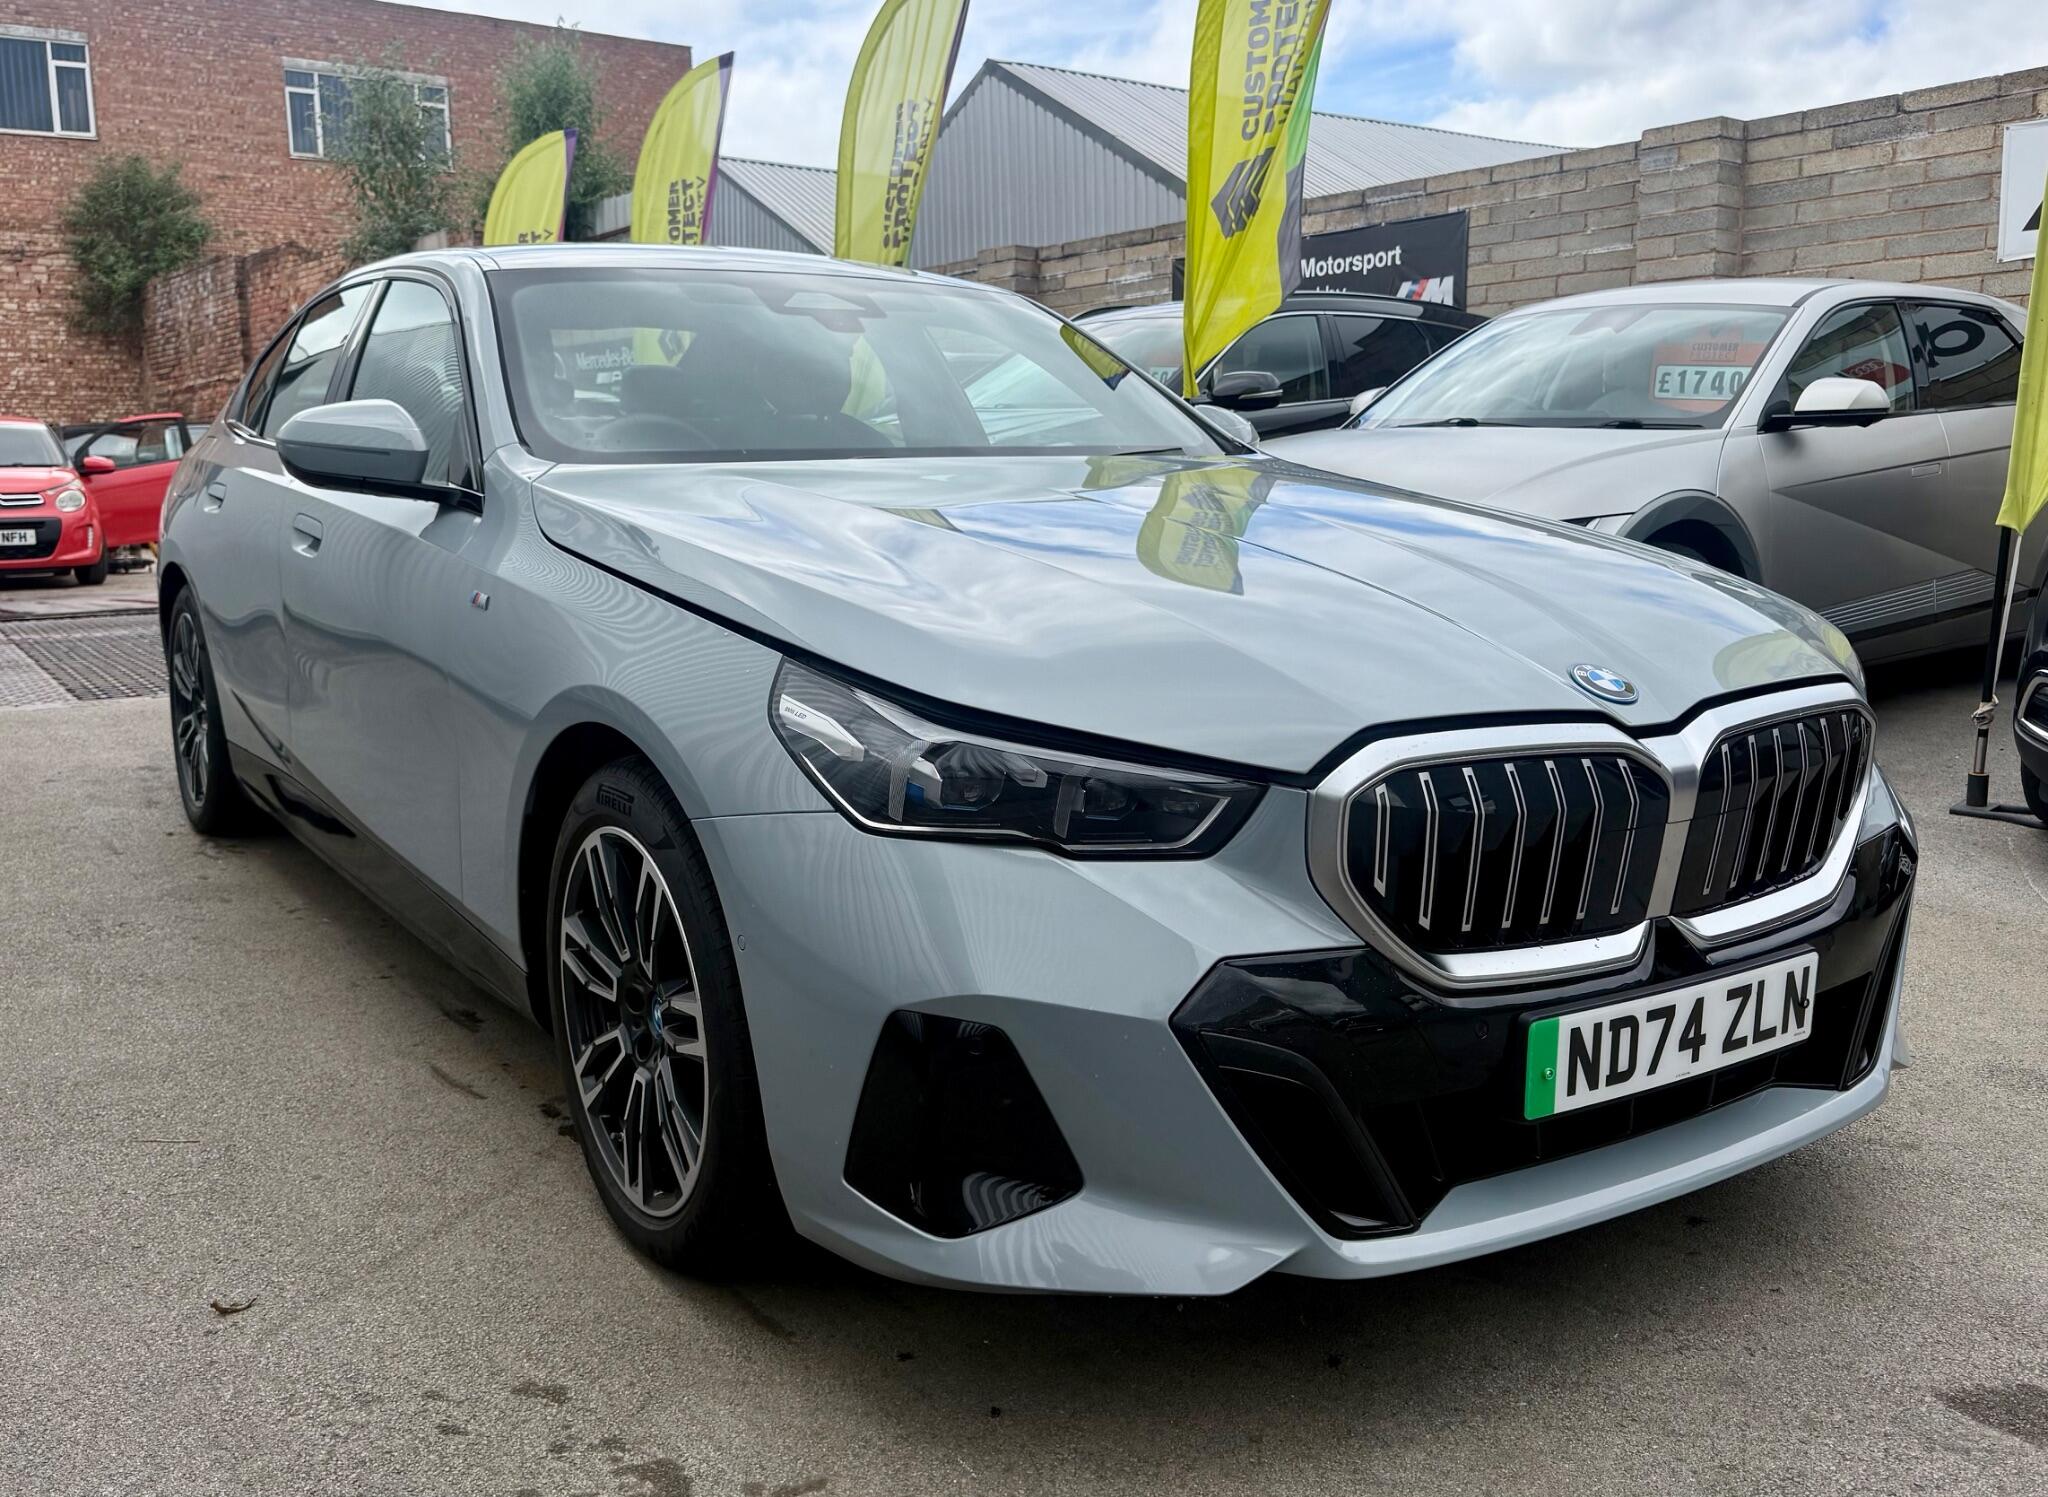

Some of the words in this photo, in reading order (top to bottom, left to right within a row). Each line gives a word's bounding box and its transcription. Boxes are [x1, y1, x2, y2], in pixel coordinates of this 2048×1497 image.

[1263, 0, 1299, 134] PROTE
[668, 180, 681, 241] OMER
[682, 178, 698, 245] TECT
[1301, 245, 1402, 278] Motorsport
[2, 532, 28, 543] NFH
[597, 783, 635, 818] PIRELLI
[1567, 996, 1706, 1097] ND74
[1722, 965, 1811, 1055] ZLN
